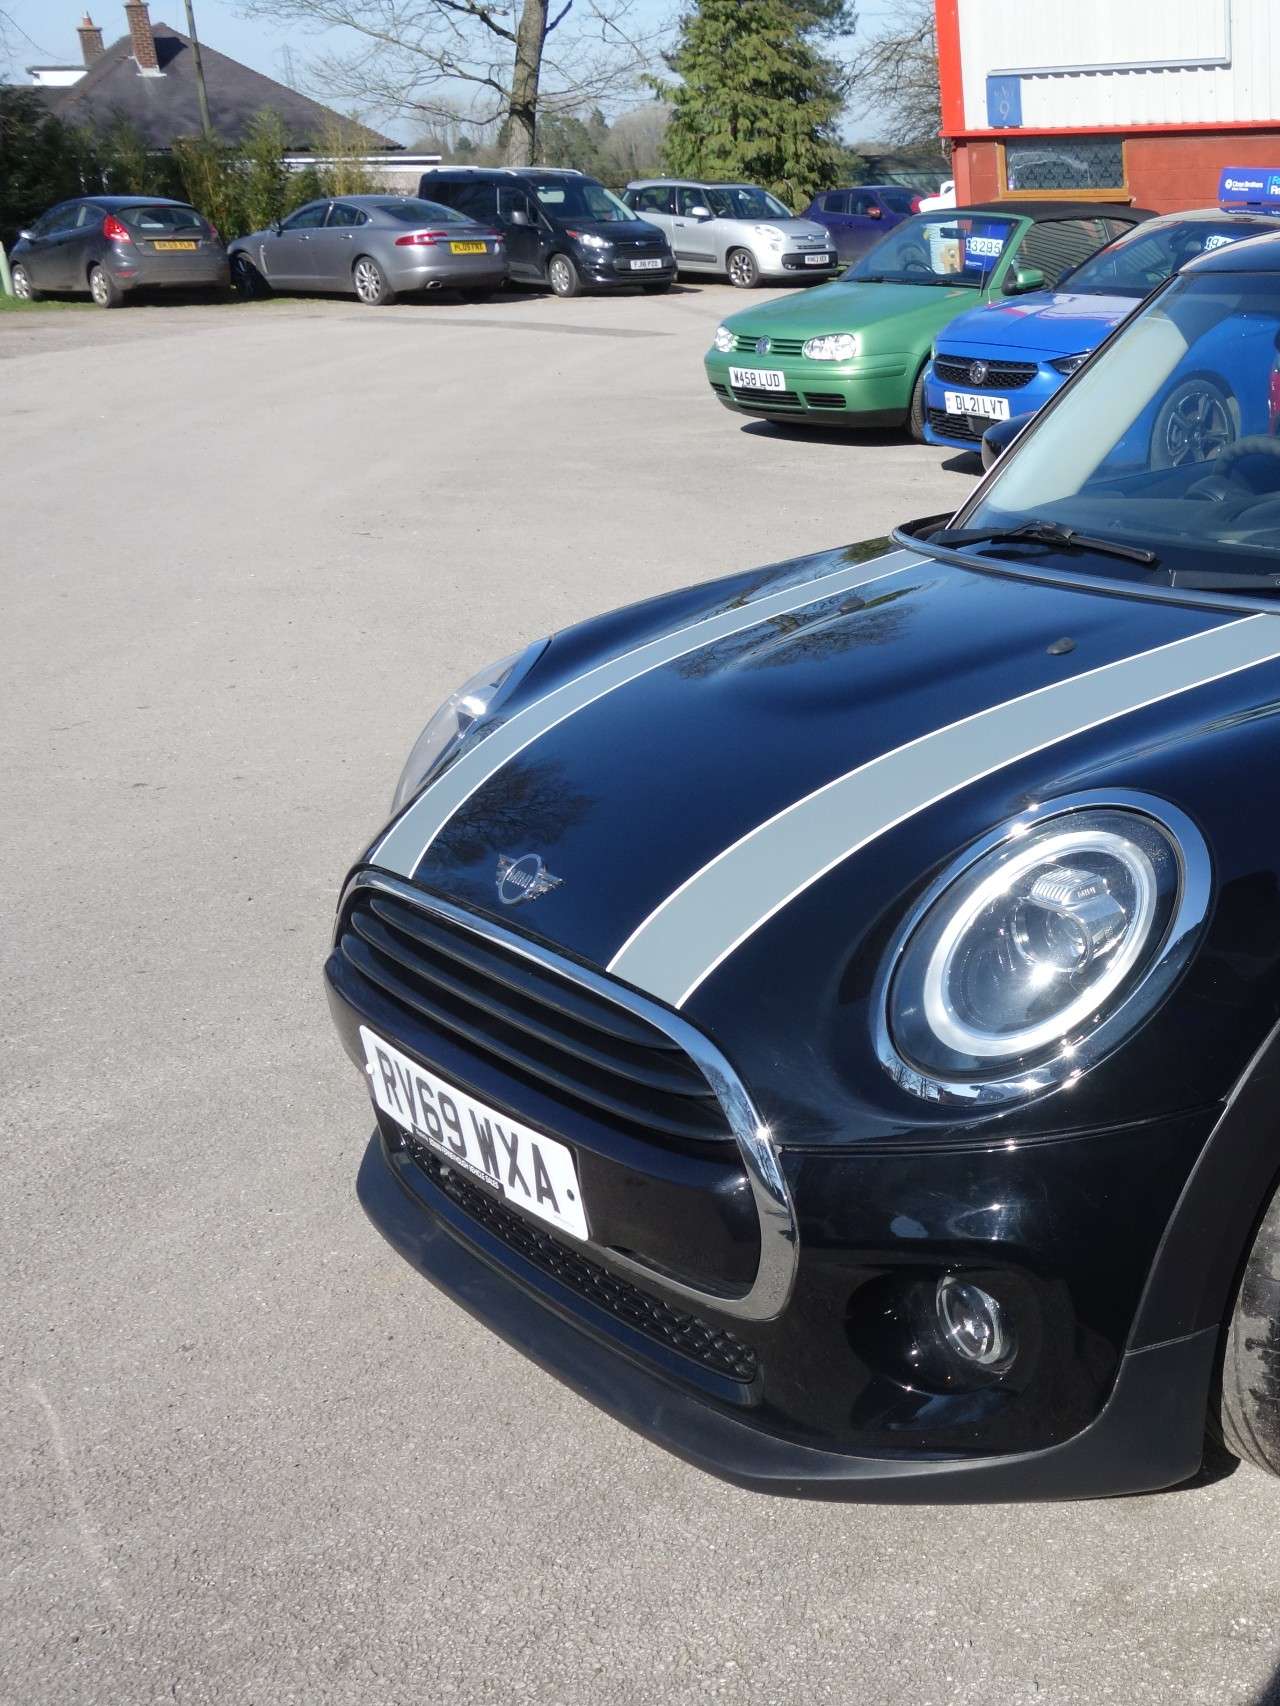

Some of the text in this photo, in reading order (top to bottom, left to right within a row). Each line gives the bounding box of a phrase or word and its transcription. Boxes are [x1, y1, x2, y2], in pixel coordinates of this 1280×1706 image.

[1000, 100, 1010, 121] 9
[966, 238, 1001, 255] £3295
[733, 370, 780, 387] W458 LUD
[955, 395, 1004, 415] DL21 LVT
[376, 1046, 561, 1214] RV69 WXA
